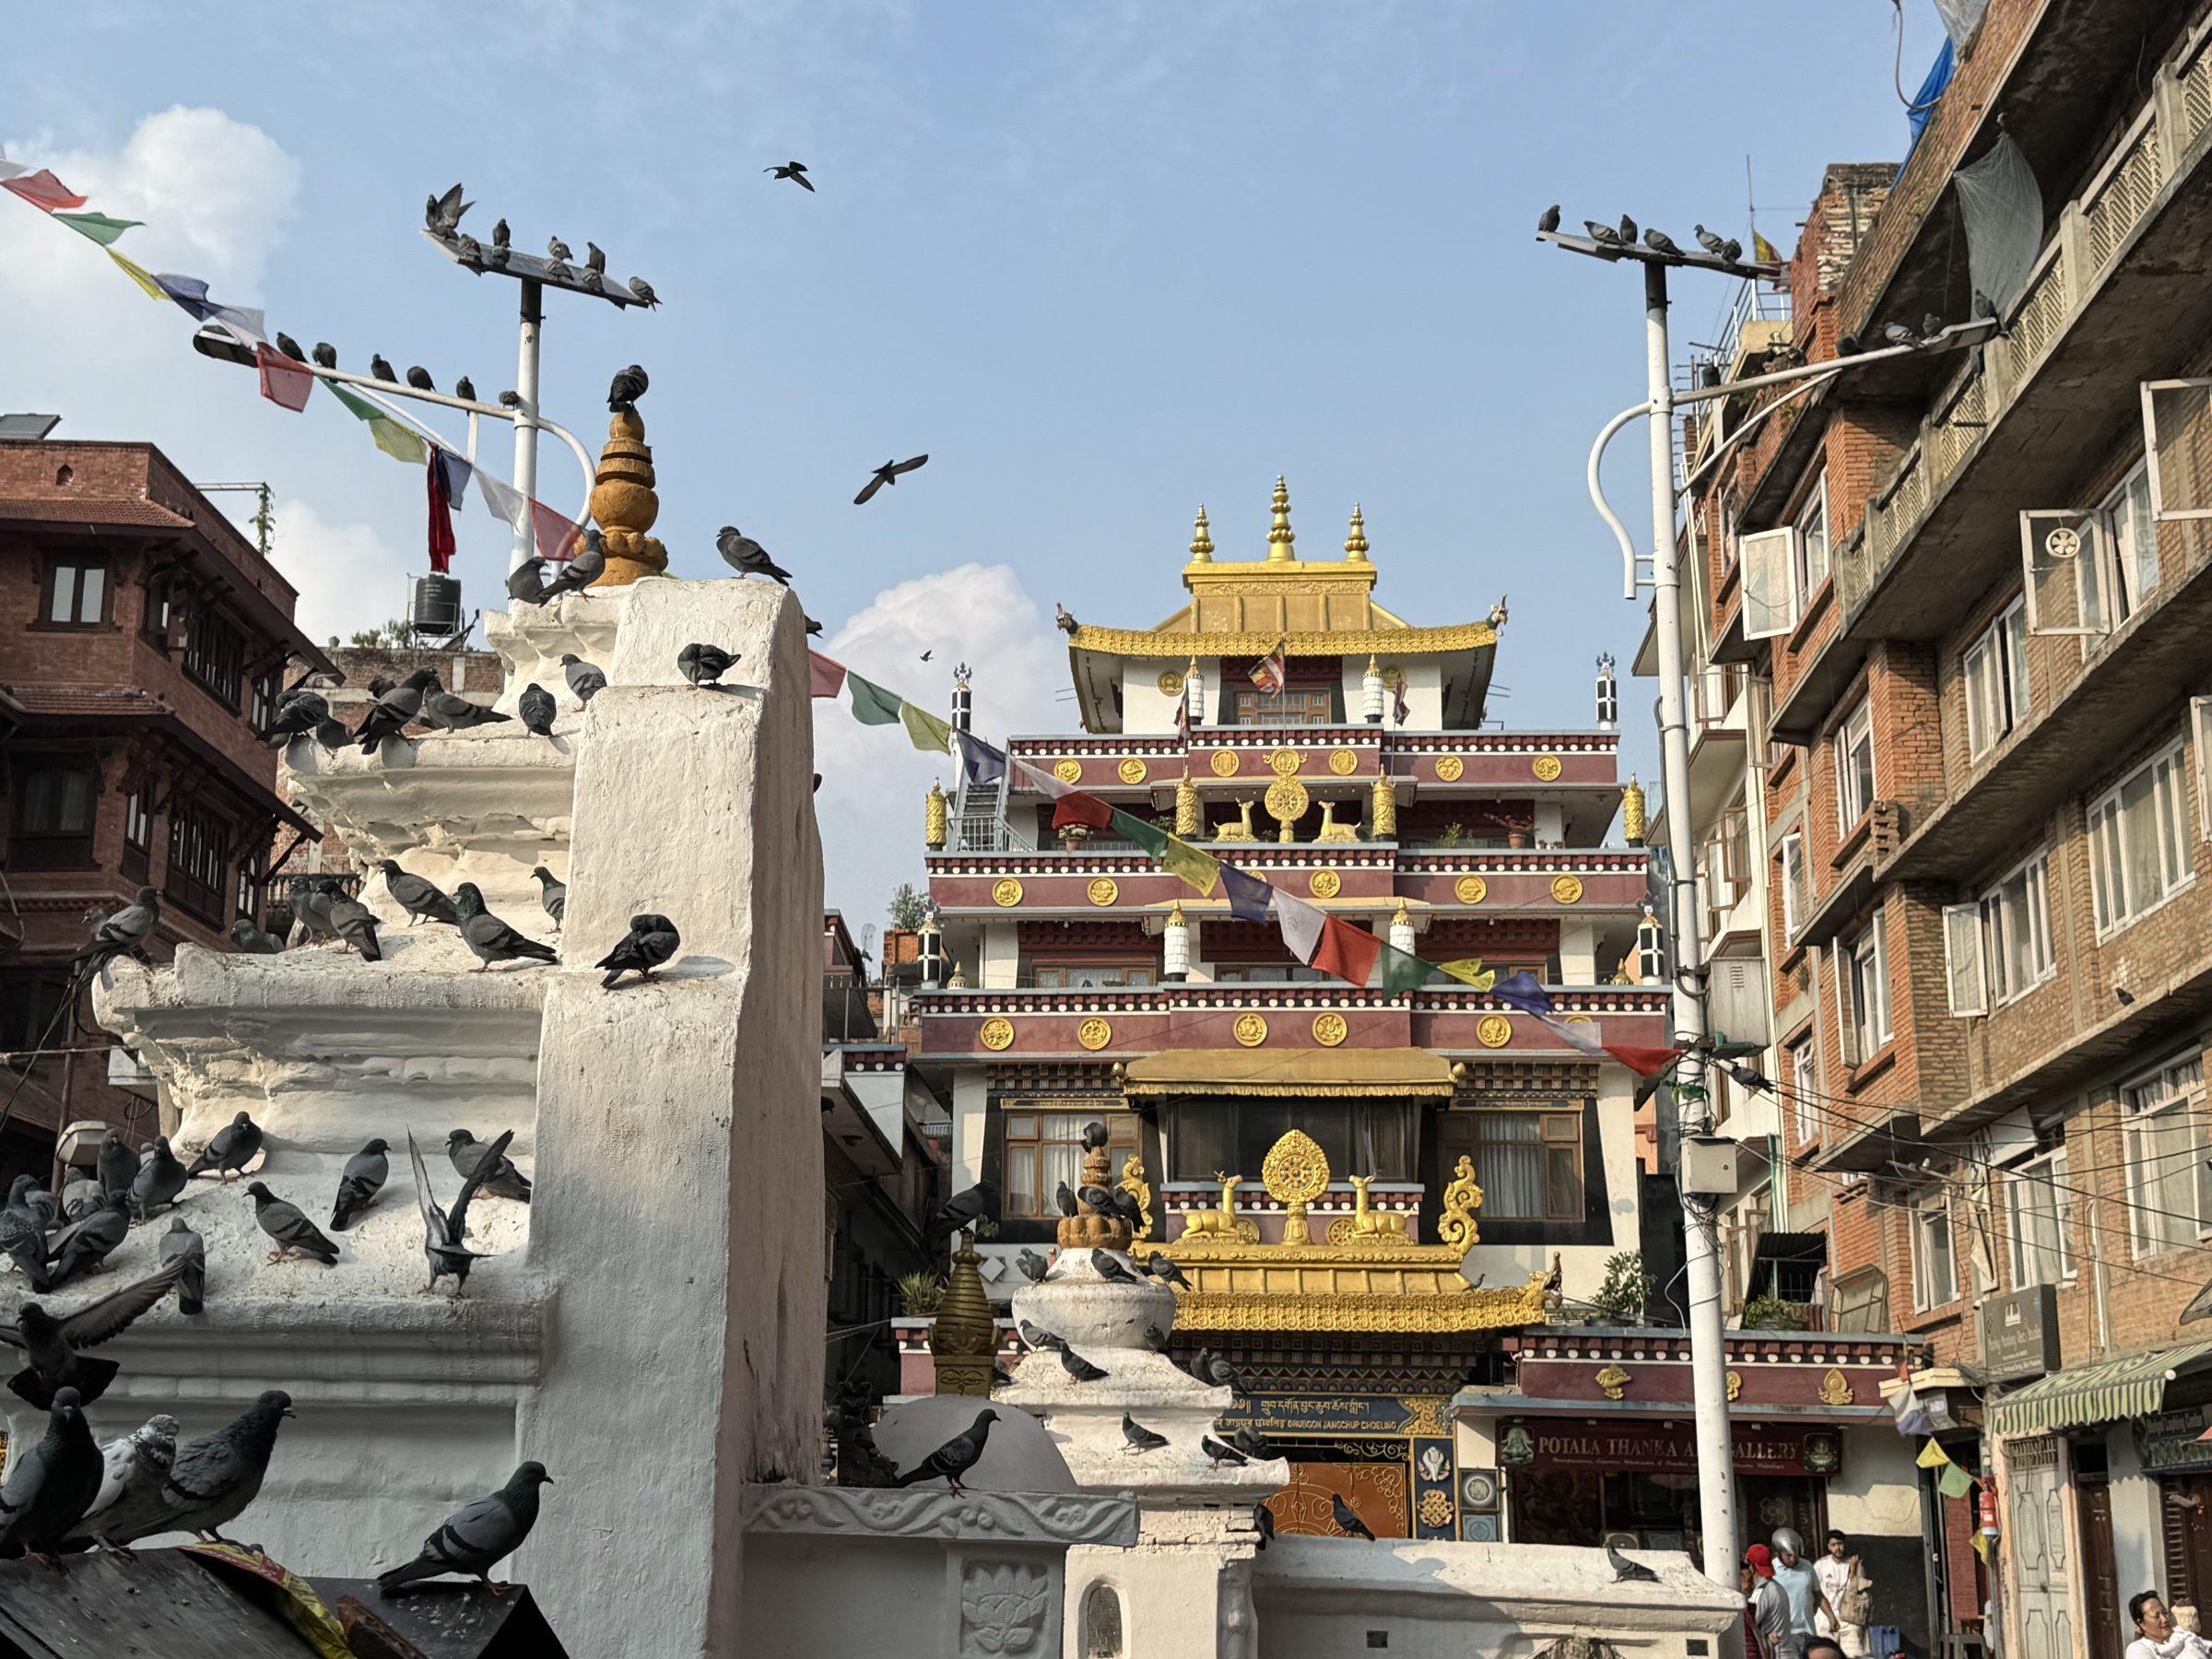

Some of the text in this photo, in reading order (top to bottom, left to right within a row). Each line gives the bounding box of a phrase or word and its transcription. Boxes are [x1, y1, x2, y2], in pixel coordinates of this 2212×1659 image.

[1288, 1419, 1322, 1430] DRUBGON
[1323, 1420, 1360, 1430] JANGCHUP
[1361, 1420, 1397, 1430] CHOELING
[1538, 1437, 1601, 1454] POTALA
[1607, 1438, 1677, 1457] THANKA
